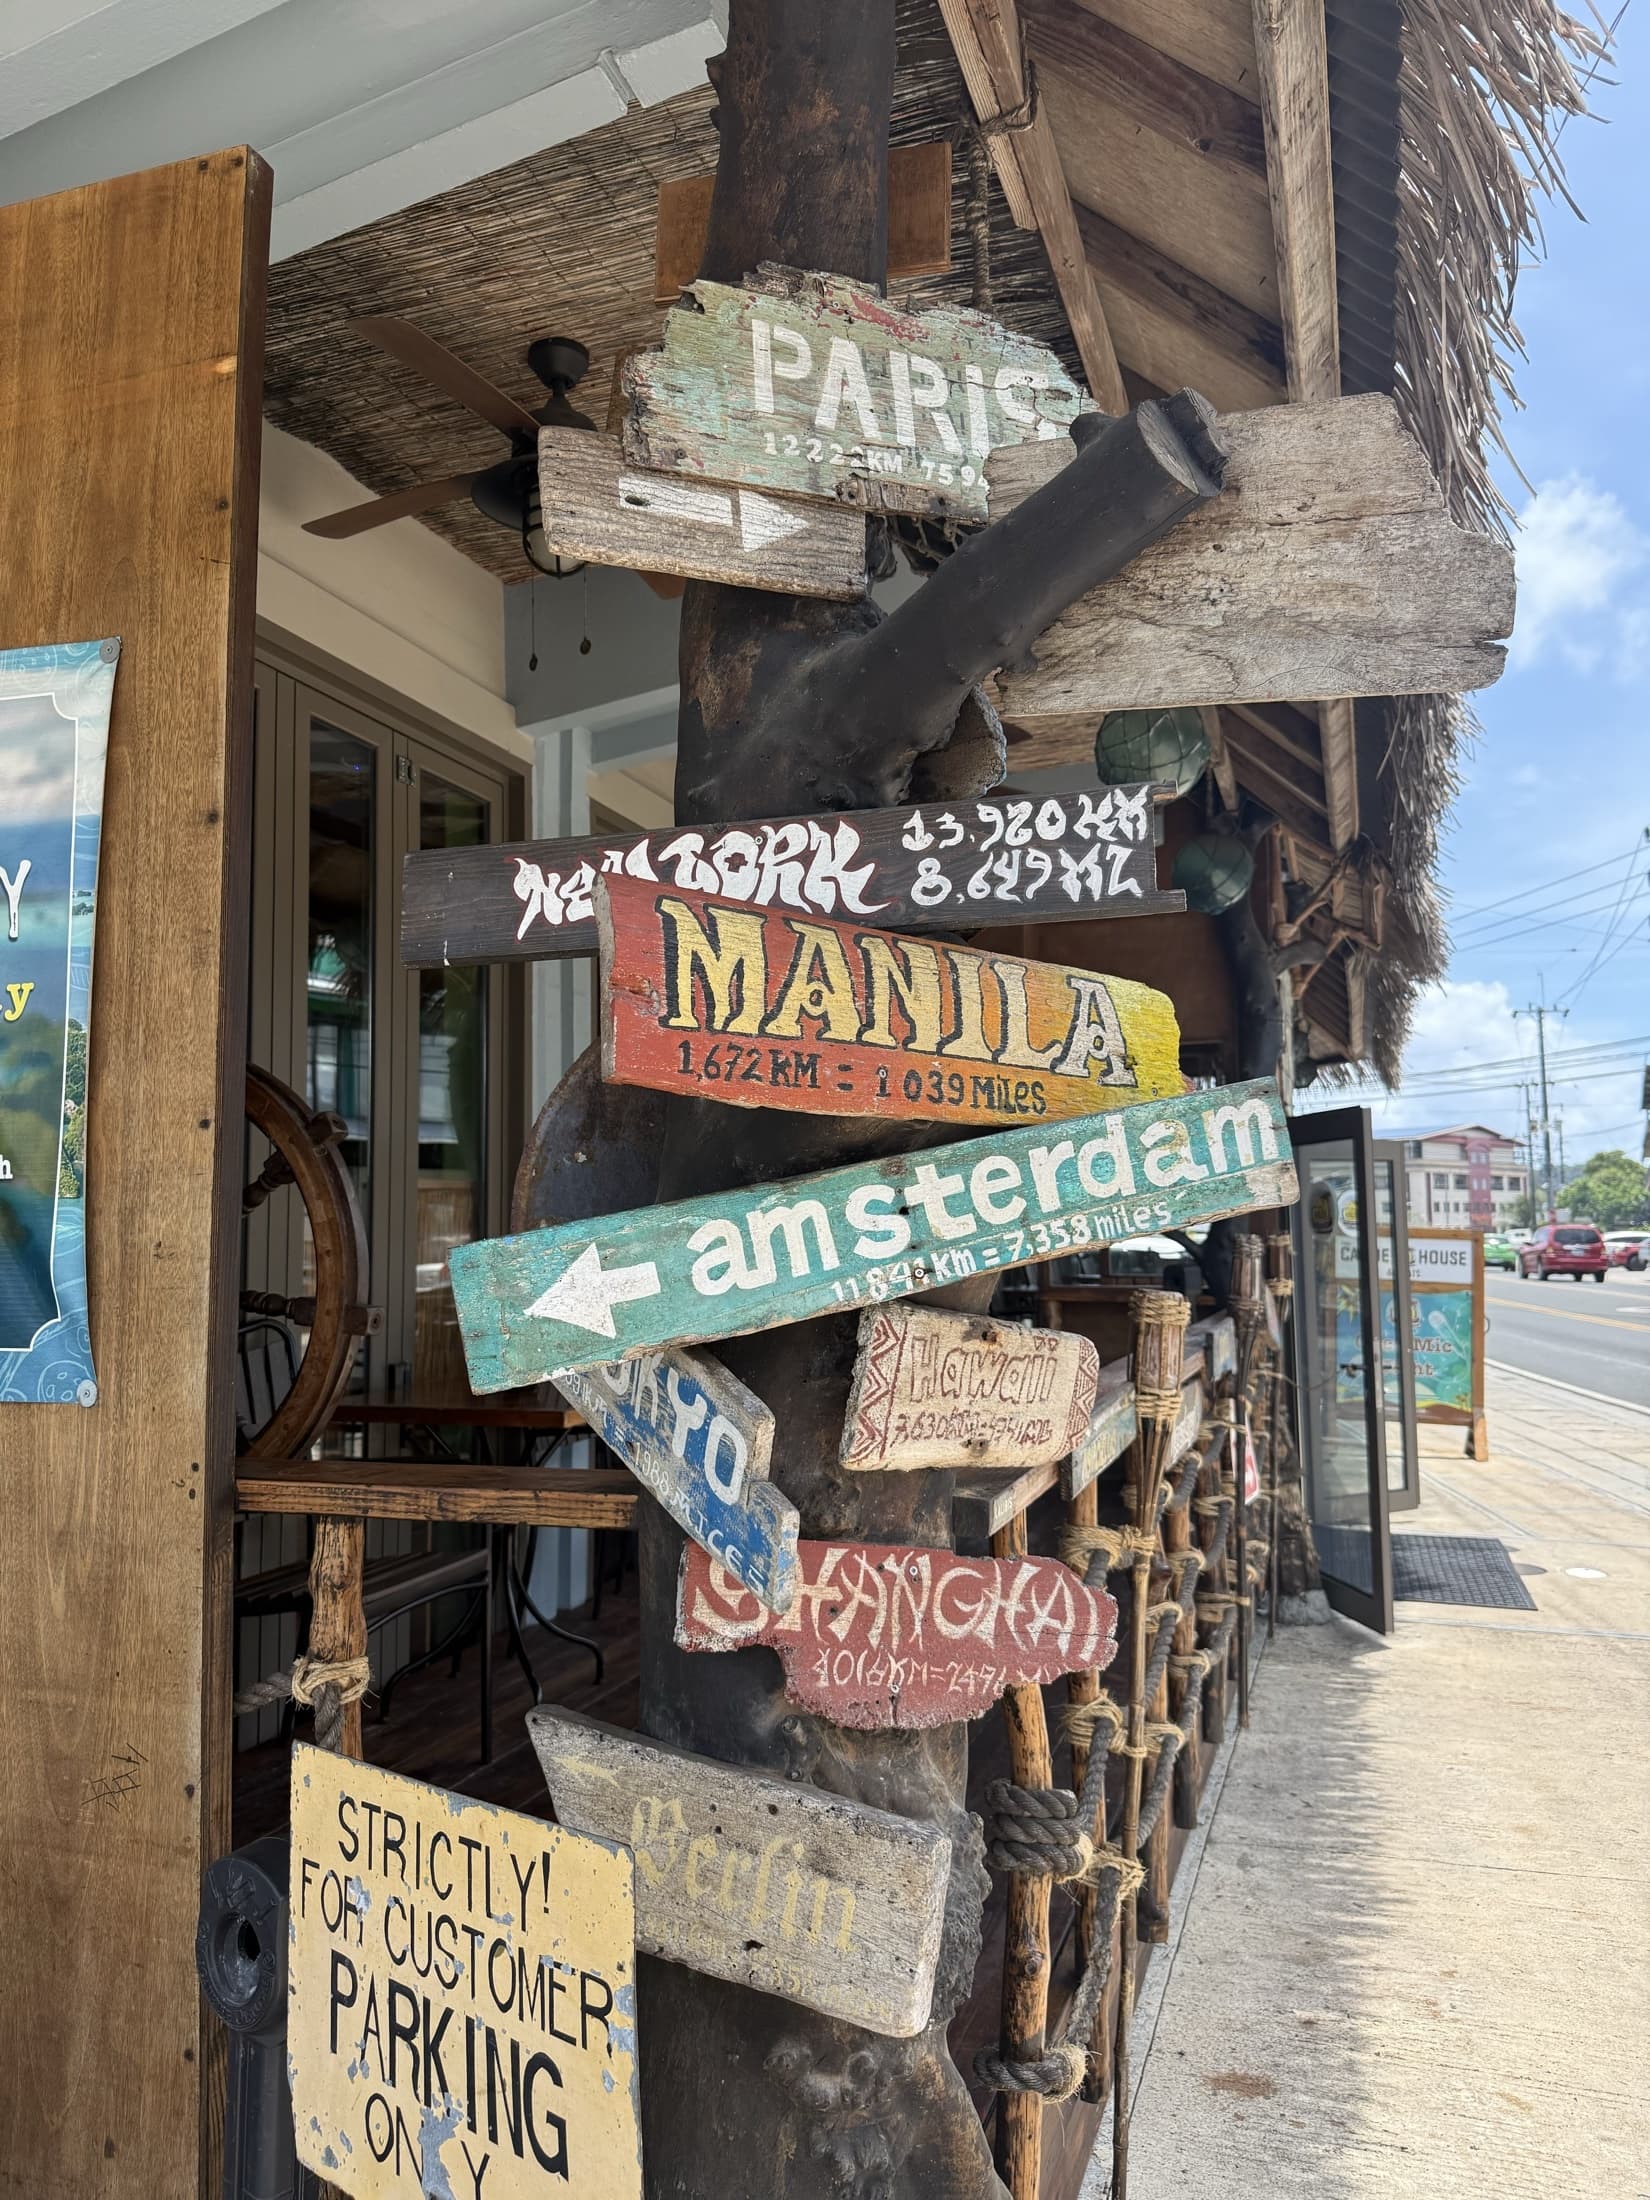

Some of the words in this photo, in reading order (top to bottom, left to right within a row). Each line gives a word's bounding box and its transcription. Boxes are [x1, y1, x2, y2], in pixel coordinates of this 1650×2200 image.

[751, 319, 1057, 456] PARIS
[655, 896, 1137, 1088] MANILA
[686, 1097, 1278, 1296] amsterdam
[1418, 1250, 1467, 1266] HOUSE
[909, 1334, 1058, 1404] Hawaii
[338, 1796, 552, 1933] STRICTLY!
[302, 1858, 373, 1947] FOR
[384, 1896, 613, 2058] CUSTOMER
[330, 1950, 570, 2182] PARKING
[365, 2093, 491, 2199] ONY
